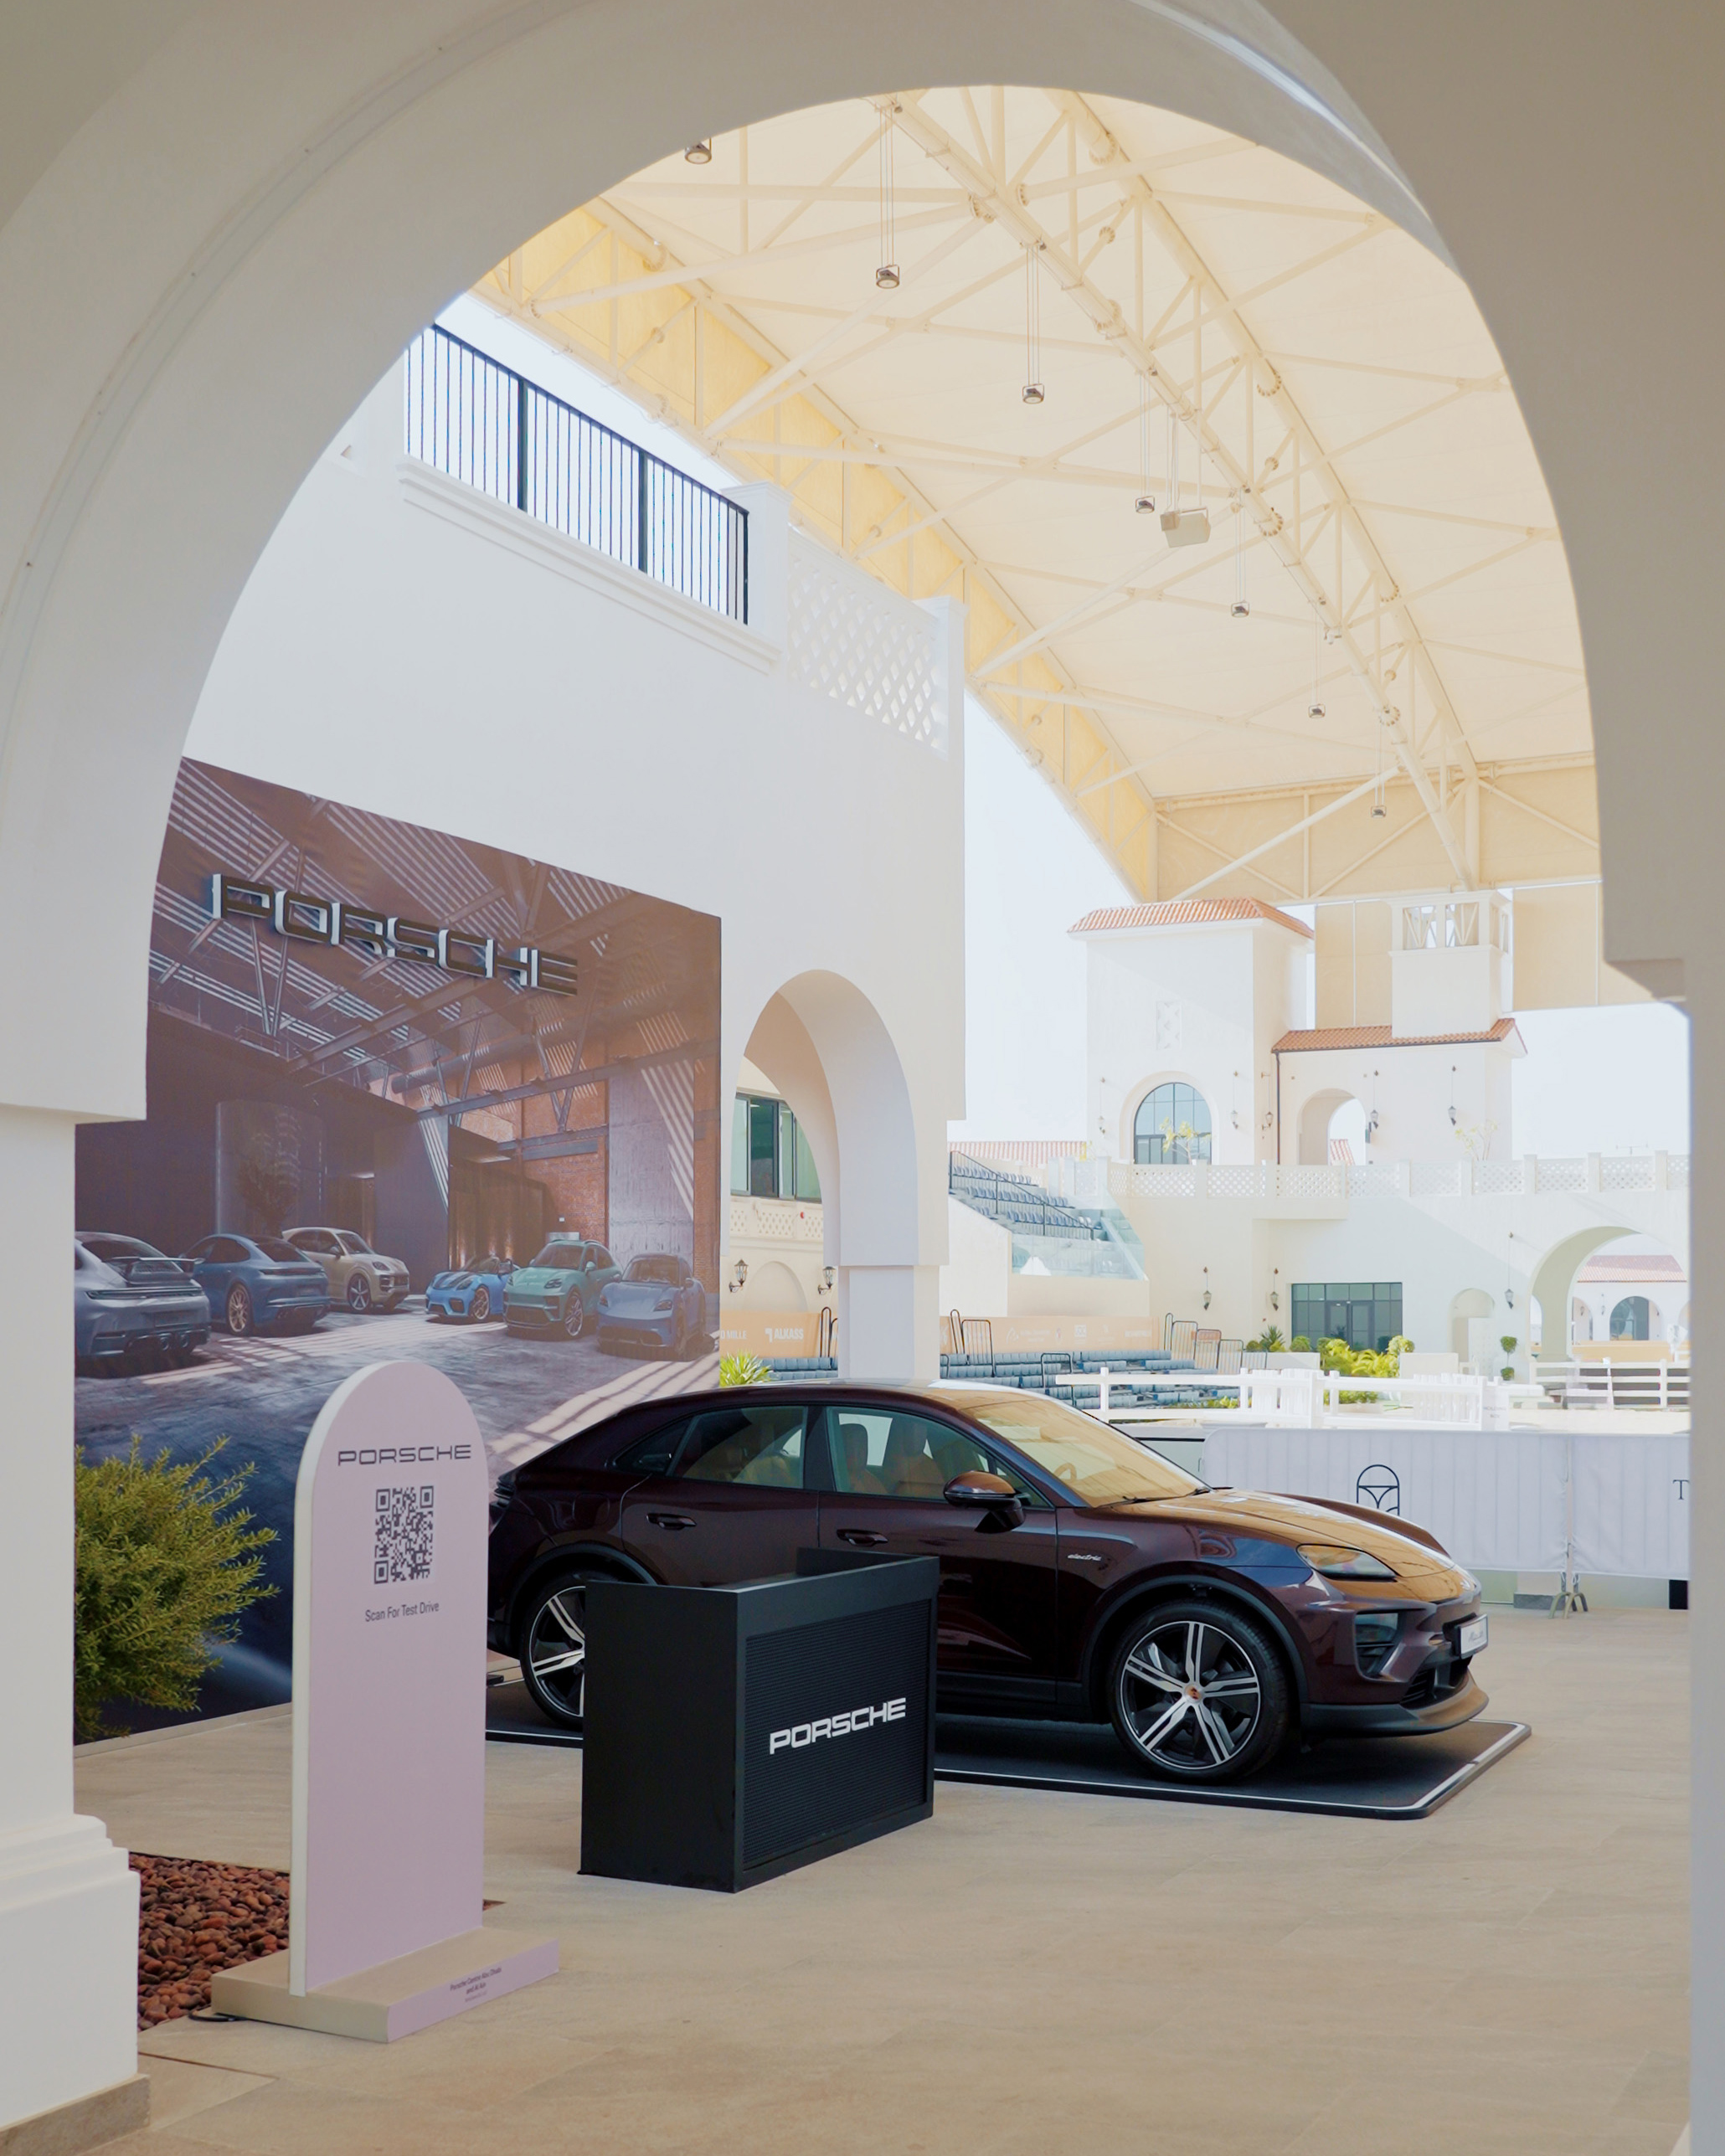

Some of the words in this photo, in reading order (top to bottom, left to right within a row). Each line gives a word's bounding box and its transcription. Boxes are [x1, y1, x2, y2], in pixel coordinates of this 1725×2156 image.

[212, 873, 578, 996] PORSCHE
[774, 1328, 804, 1340] ALKASS
[337, 1444, 471, 1466] PORSCHE
[365, 1609, 385, 1622] Scan
[387, 1606, 400, 1618] For
[401, 1604, 417, 1616] Test
[420, 1601, 439, 1614] Drive
[769, 1697, 906, 1755] PORSCHE
